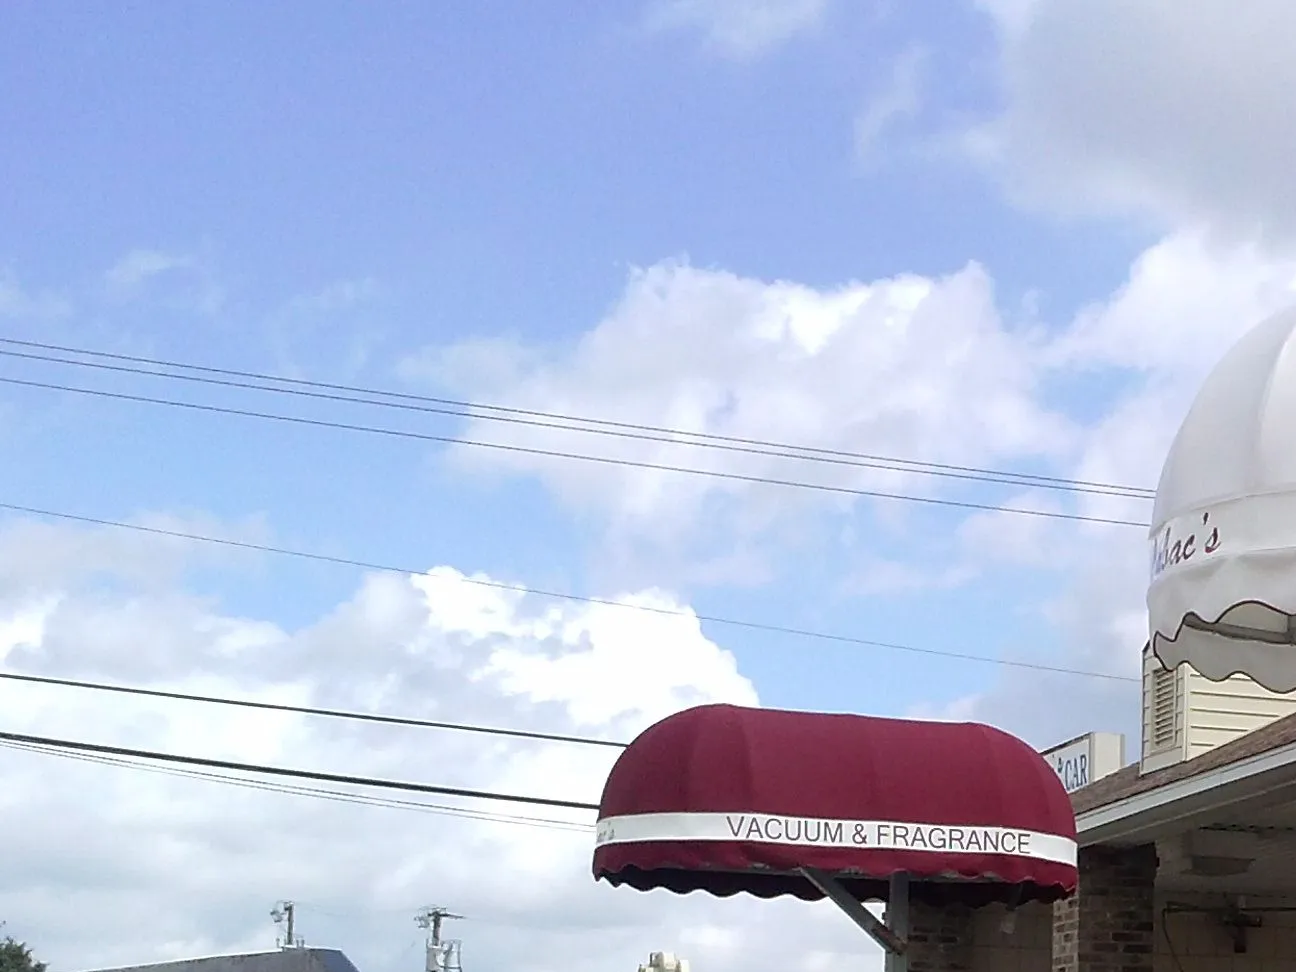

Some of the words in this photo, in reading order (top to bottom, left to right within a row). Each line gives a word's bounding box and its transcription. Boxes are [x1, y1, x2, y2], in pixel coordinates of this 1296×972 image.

[1064, 754, 1087, 791] CAR
[726, 815, 843, 843] VACUUM
[851, 823, 867, 845] &
[877, 824, 1031, 854] FRAGRANCE
